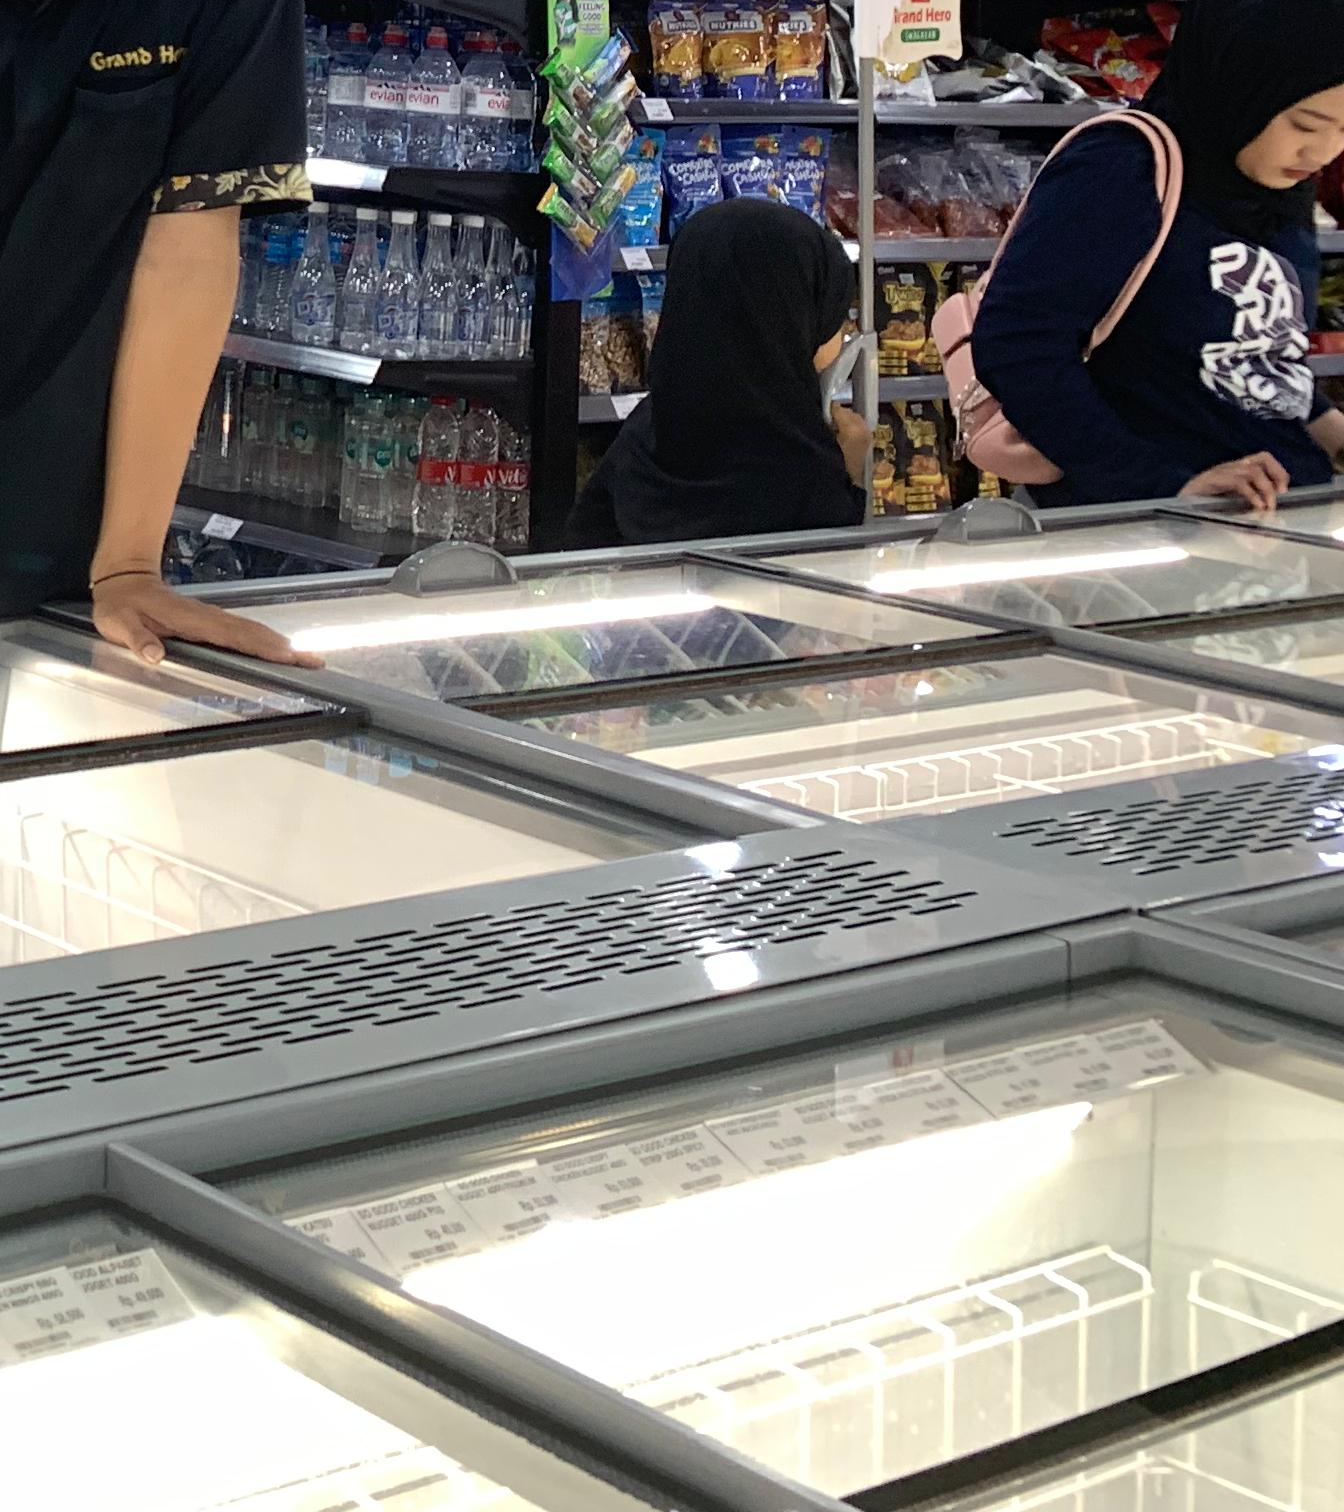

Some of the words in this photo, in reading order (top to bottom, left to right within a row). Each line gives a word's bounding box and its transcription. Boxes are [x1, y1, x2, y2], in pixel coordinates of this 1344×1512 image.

[925, 7, 952, 21] Hero
[90, 46, 153, 72] Grand
[370, 90, 405, 103] evian
[408, 92, 439, 105] evian
